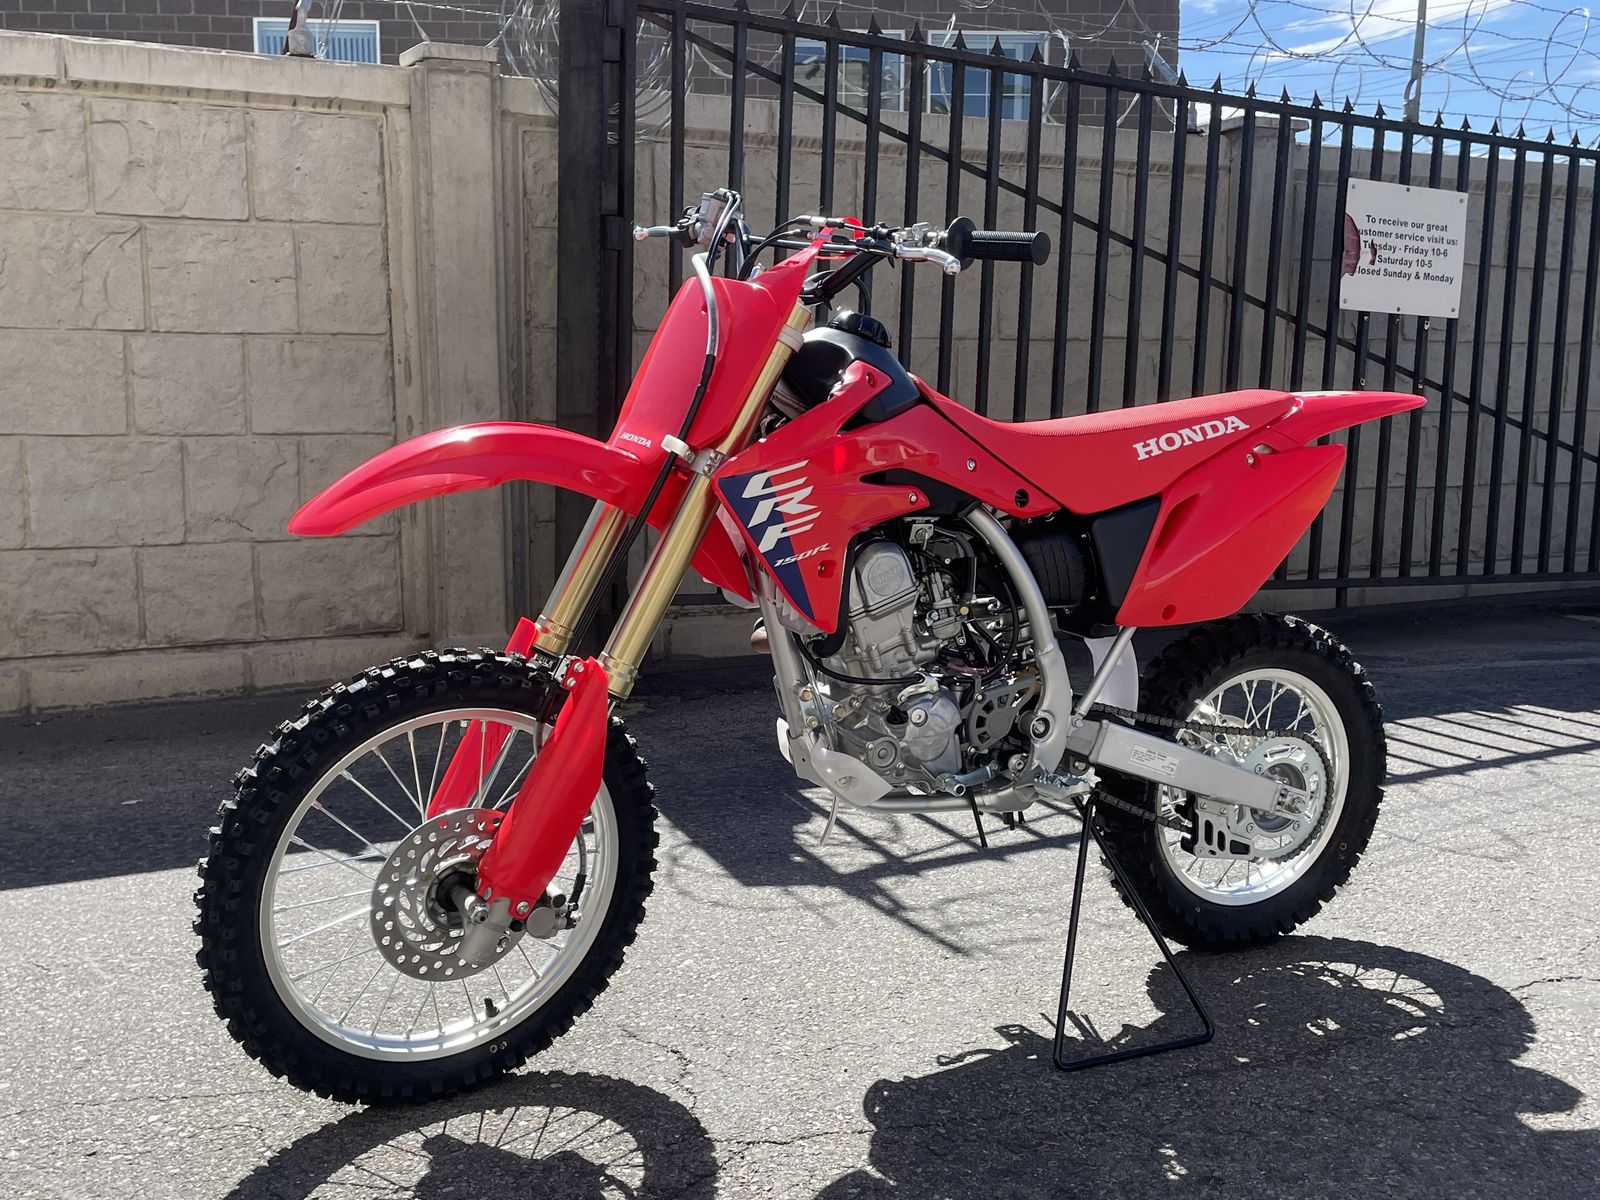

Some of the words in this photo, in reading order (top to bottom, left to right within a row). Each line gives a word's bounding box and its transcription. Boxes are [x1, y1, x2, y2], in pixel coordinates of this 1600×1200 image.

[1366, 214, 1377, 224] To
[1379, 217, 1409, 228] receive
[1411, 221, 1424, 229] our
[1427, 223, 1448, 232] great
[1359, 228, 1393, 239] ustomer
[1395, 232, 1425, 242] service
[1427, 234, 1444, 245] visit
[1446, 238, 1458, 246] us:
[1404, 245, 1429, 257] Friday
[1432, 247, 1448, 258] 10-6
[1377, 255, 1413, 268] Saturday
[1416, 258, 1433, 268] 10-5
[1356, 266, 1381, 276] losed
[1383, 268, 1412, 281] Sunday
[1414, 271, 1420, 280] &
[1423, 272, 1454, 285] Monday
[620, 432, 652, 448] HONDA
[1133, 415, 1250, 461] HONDA
[741, 459, 822, 554] CRF
[773, 542, 831, 568] 150R
